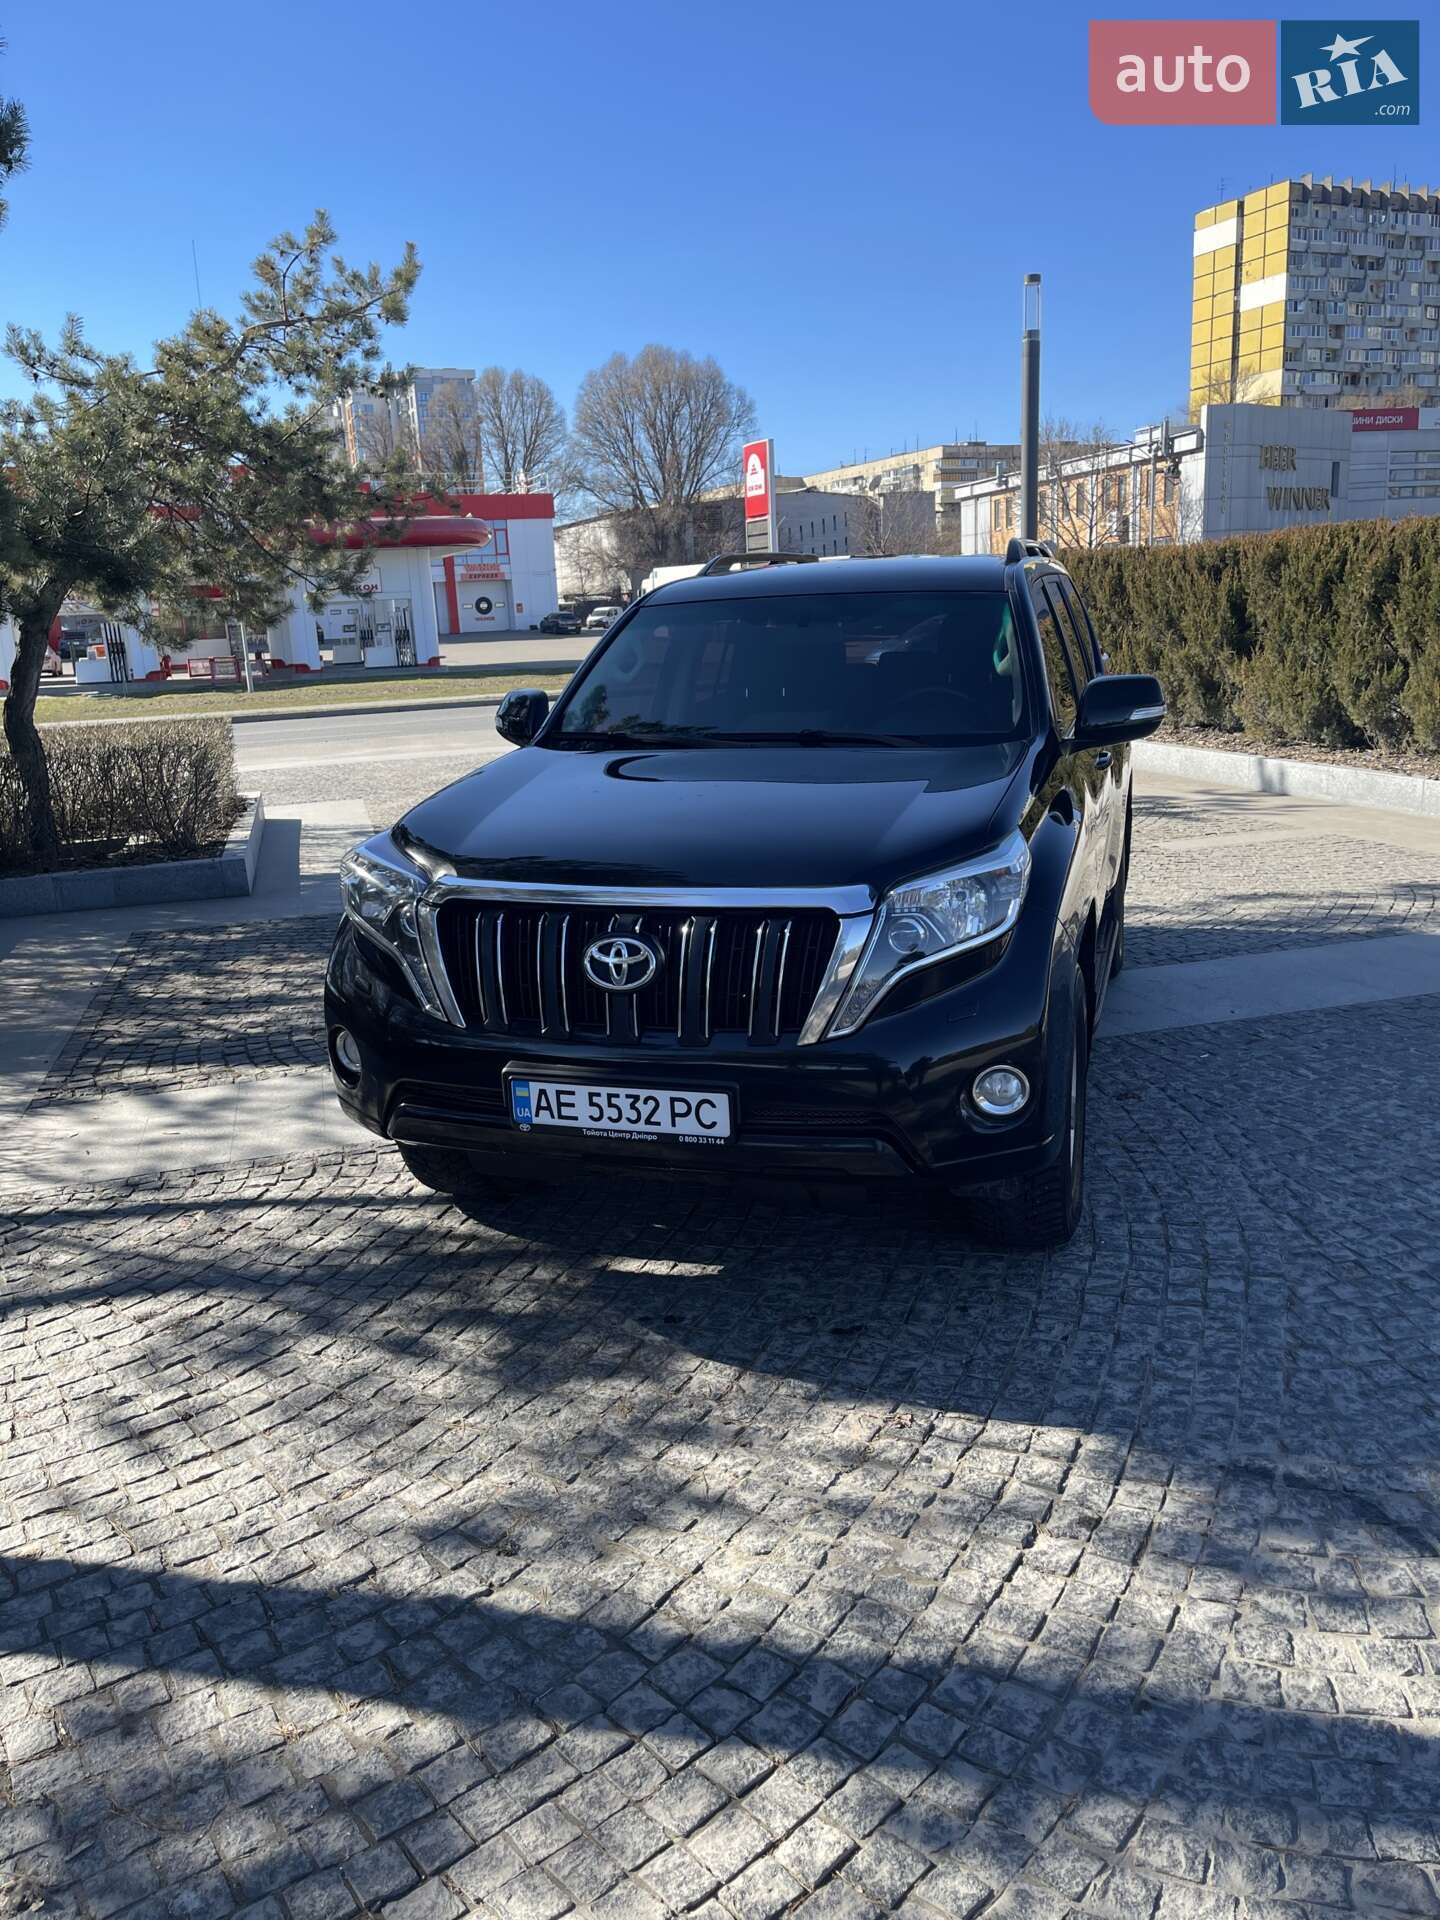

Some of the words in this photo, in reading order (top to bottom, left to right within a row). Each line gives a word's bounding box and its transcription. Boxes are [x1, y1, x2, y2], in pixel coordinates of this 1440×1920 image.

[1375, 415, 1403, 425] ДИСКИ
[1259, 444, 1297, 471] BEER
[1266, 487, 1331, 511] WINNER
[517, 1107, 531, 1118] UA
[534, 1088, 578, 1121] AE
[587, 1091, 662, 1127] 5532
[669, 1096, 718, 1130] PC
[582, 1128, 608, 1137] Тойота
[608, 1130, 631, 1140] Центр
[631, 1132, 658, 1141] Дніпро
